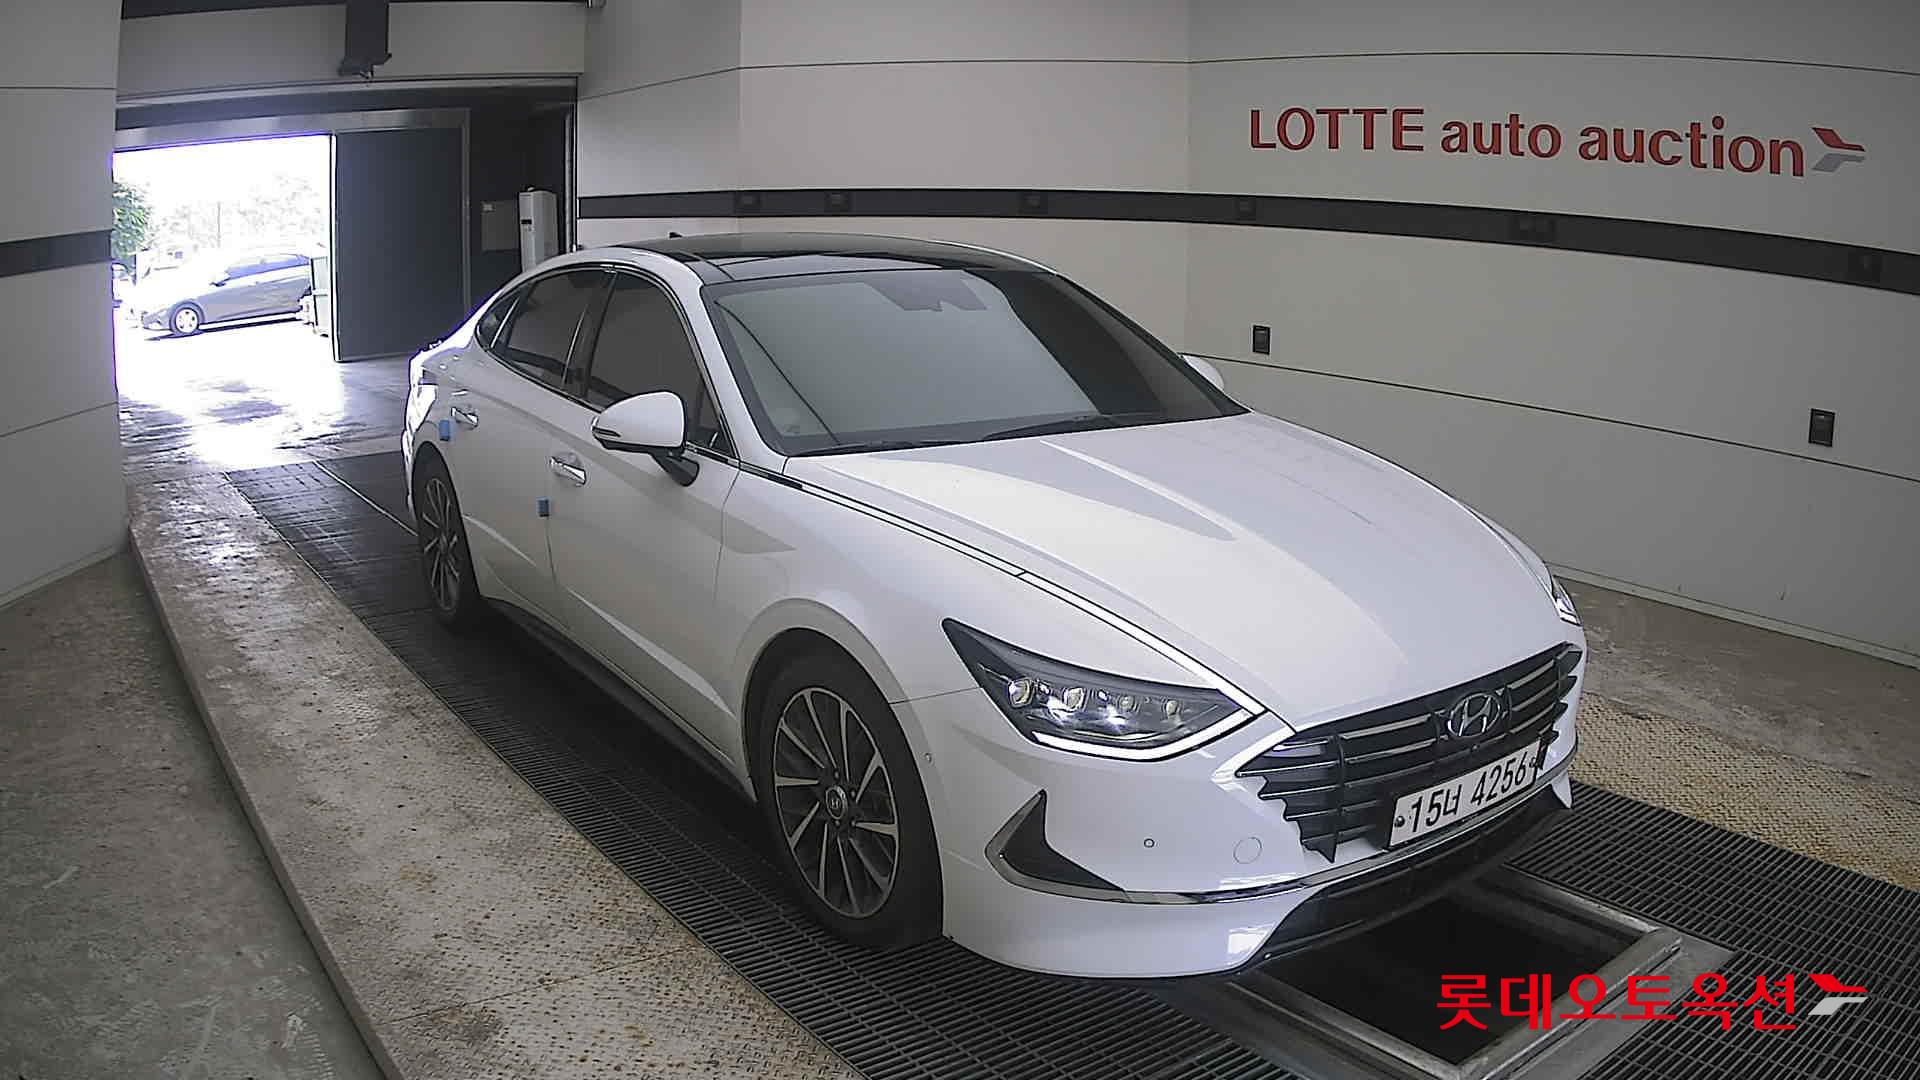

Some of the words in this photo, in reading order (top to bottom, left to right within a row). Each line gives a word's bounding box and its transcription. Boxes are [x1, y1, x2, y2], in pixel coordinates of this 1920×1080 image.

[1250, 108, 1425, 152] LOTTE
[1440, 113, 1562, 159] auto
[1577, 115, 1806, 178] auction
[1411, 783, 1463, 833] 15너
[1470, 751, 1528, 807] 4256
